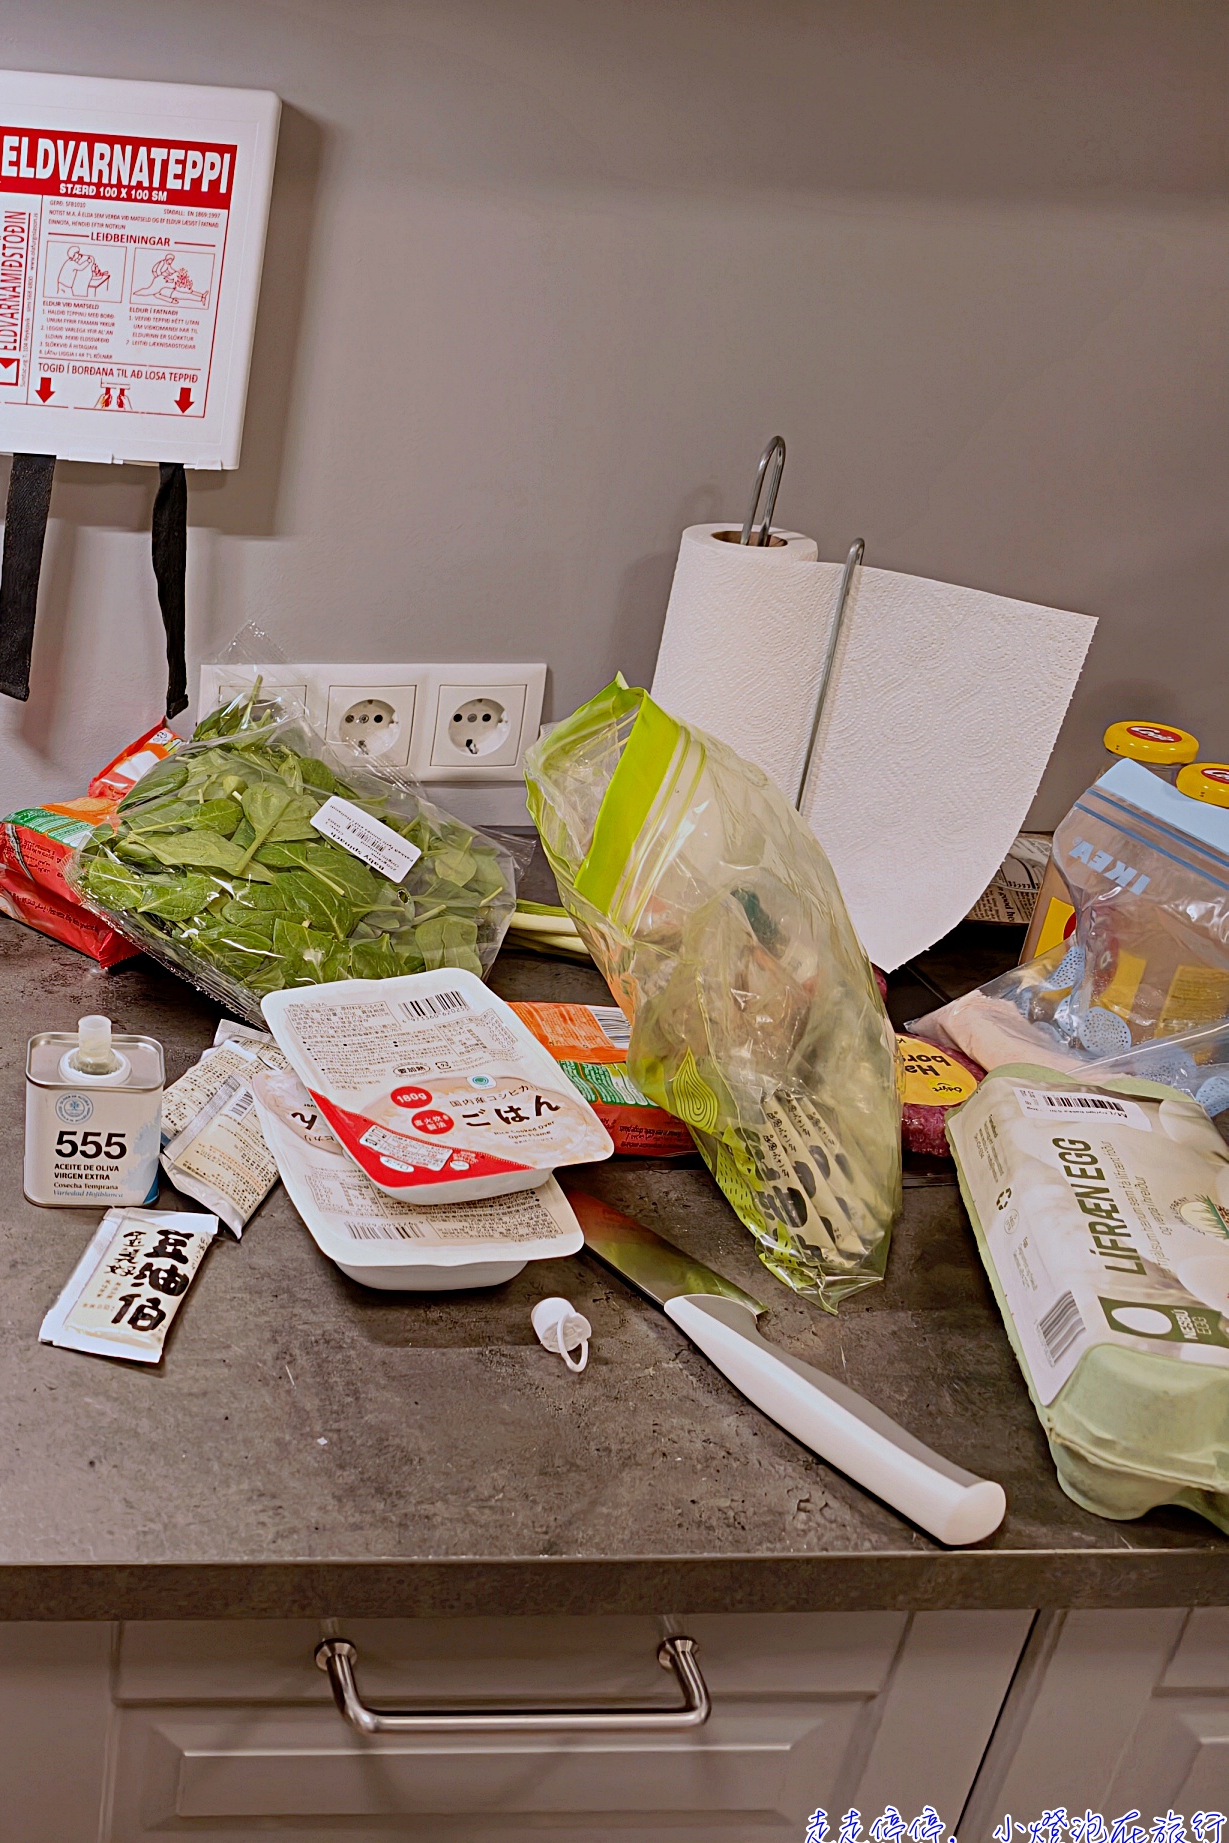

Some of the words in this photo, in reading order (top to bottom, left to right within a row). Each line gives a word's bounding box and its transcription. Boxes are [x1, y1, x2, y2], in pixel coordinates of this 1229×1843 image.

[1, 135, 230, 193] ELDVARNATEPPI
[60, 183, 96, 195] STÆRÐ
[100, 187, 117, 197] 100
[120, 188, 127, 198] X
[131, 189, 149, 200] 100
[152, 191, 167, 201] SM
[91, 232, 170, 246] LEIÐBEININGAR
[38, 362, 64, 374] TOGIÐ
[72, 364, 114, 378] BORÐANA
[117, 368, 128, 379] TIL
[130, 369, 143, 380] AÐ
[145, 370, 165, 382] LOSA
[169, 372, 198, 384] TEPPIÐ
[329, 830, 362, 855] spinach
[362, 853, 385, 871] Baby
[397, 1092, 427, 1103] 180g
[462, 1095, 561, 1126] ごはん
[55, 1131, 127, 1159] 555
[1052, 1138, 1106, 1180] EGG
[1090, 1184, 1147, 1276] LÍFRÆN
[111, 1229, 195, 1331] 豆油伯
[1192, 1316, 1212, 1335] EGG
